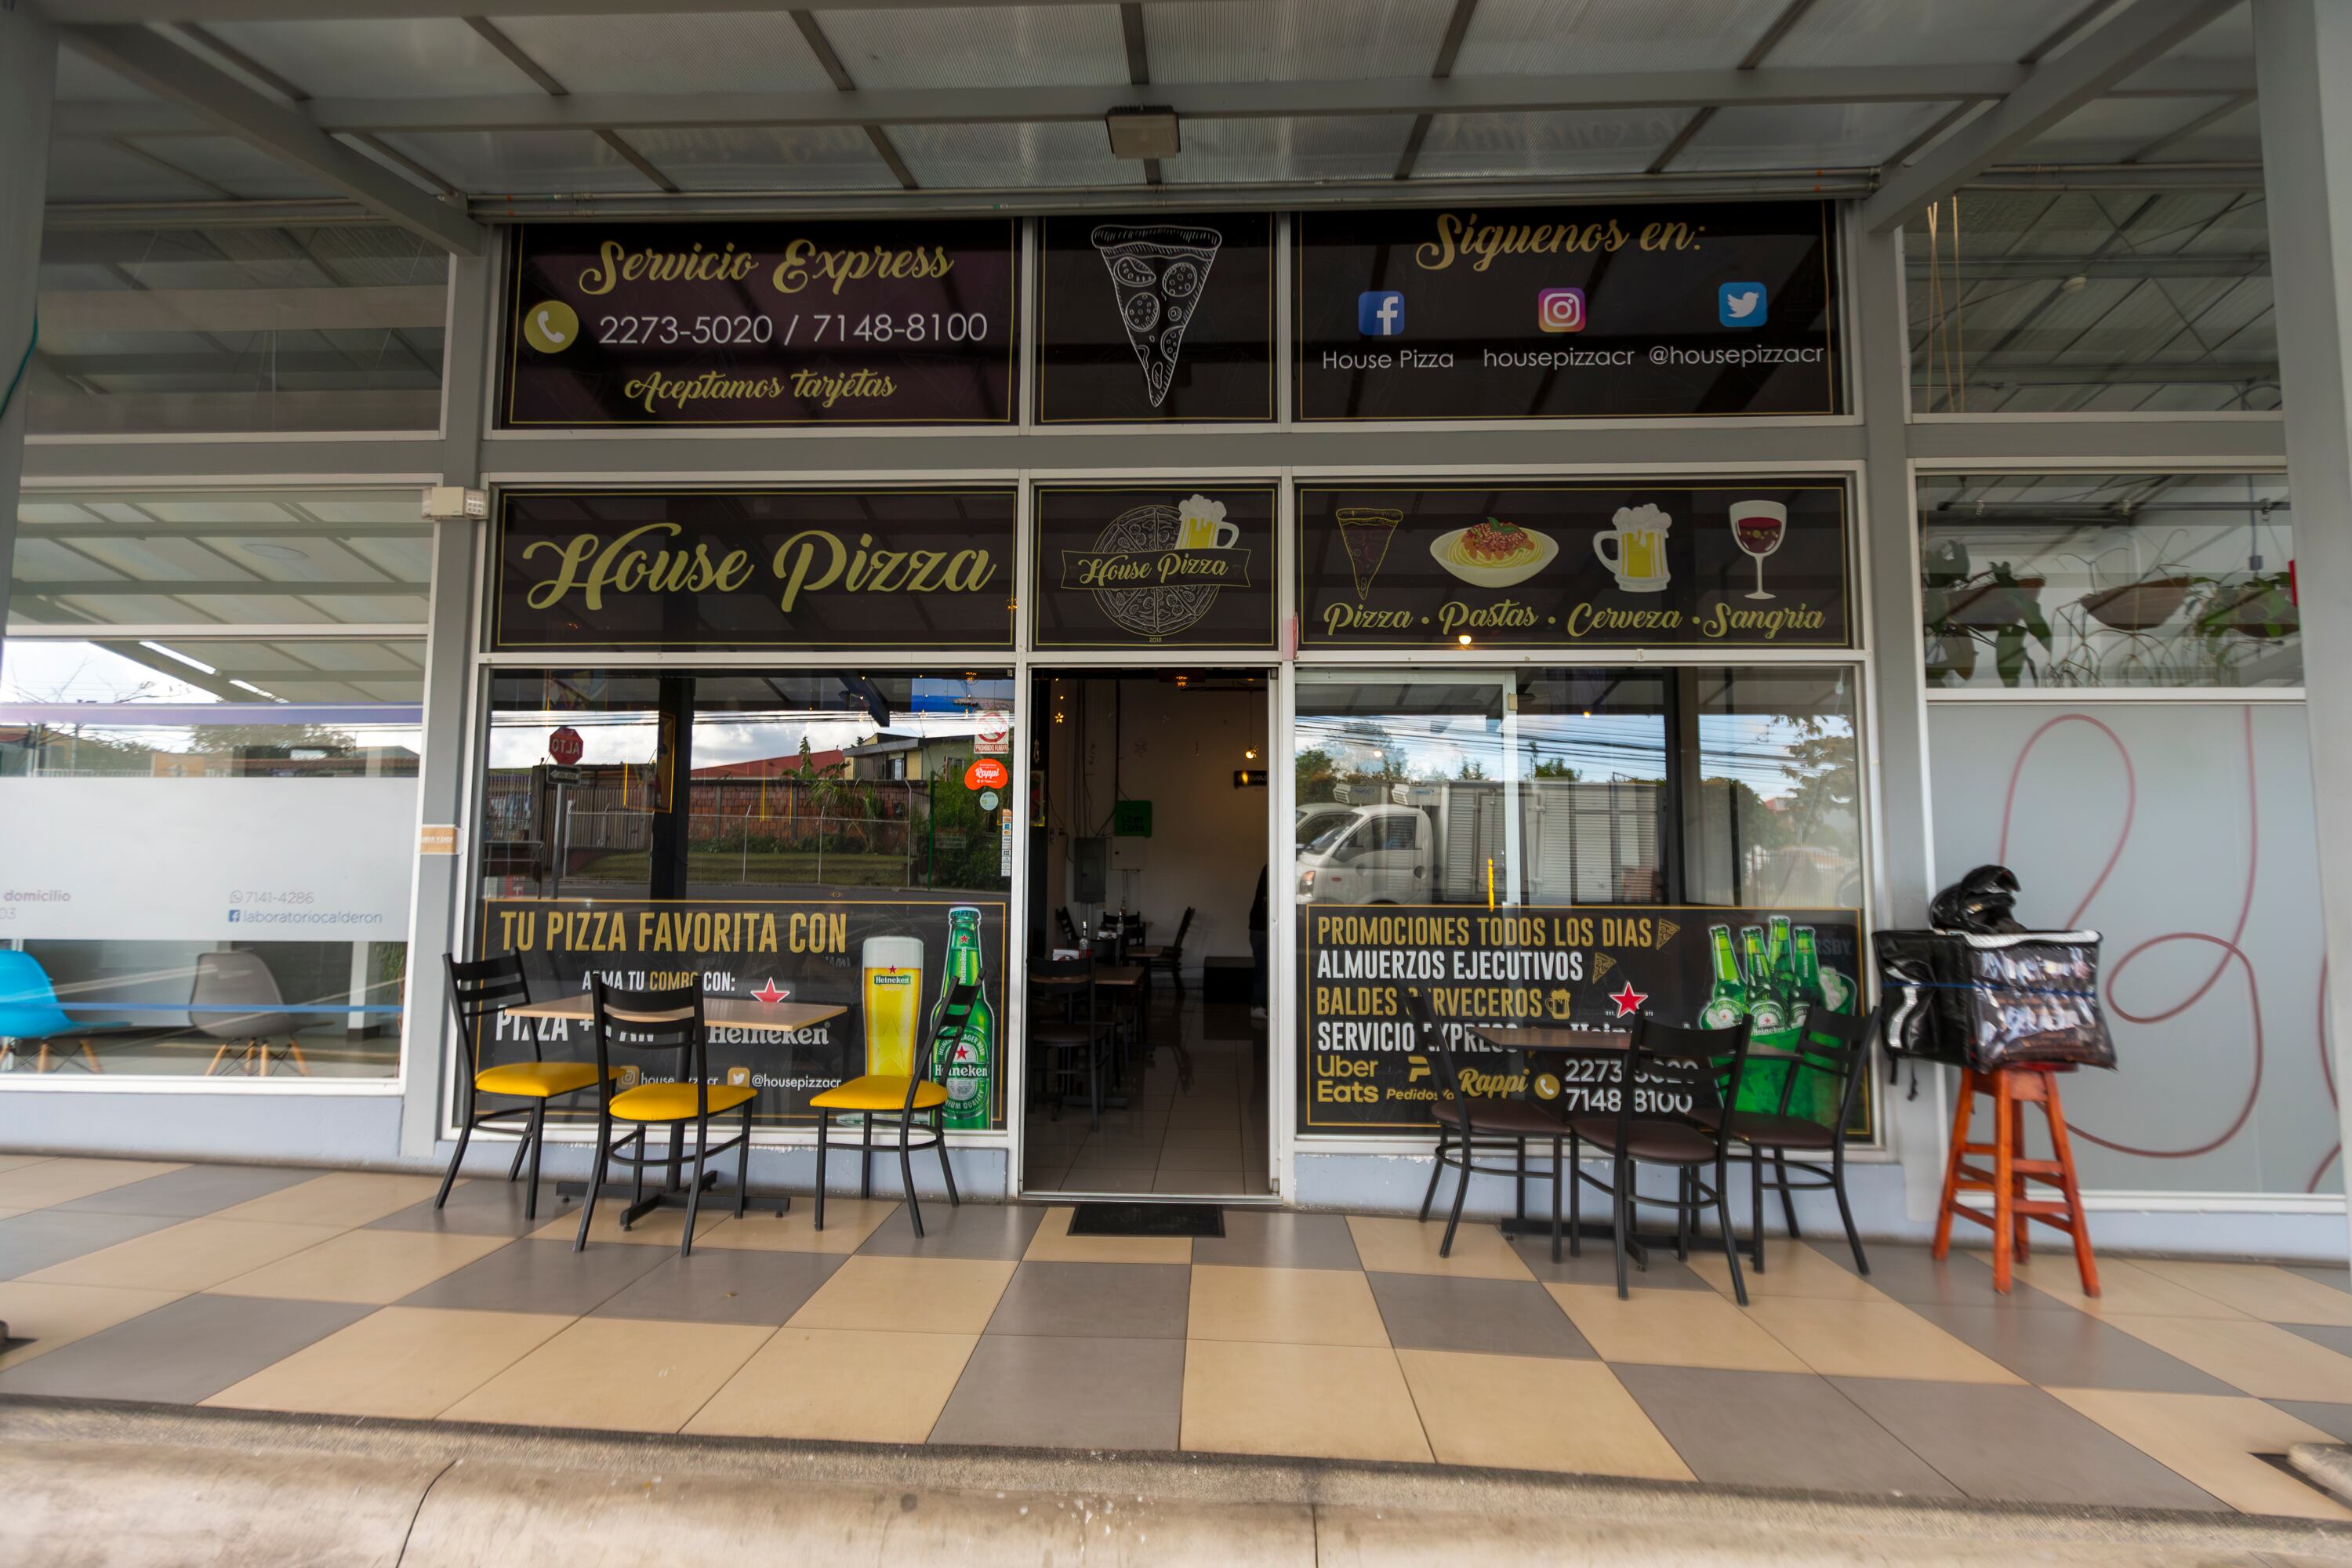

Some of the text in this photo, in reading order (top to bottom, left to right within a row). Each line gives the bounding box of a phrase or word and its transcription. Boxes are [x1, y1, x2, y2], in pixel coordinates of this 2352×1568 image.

[1639, 220, 1702, 252] en:
[579, 238, 955, 295] Servicio Express
[599, 315, 773, 344] 2273-5020
[813, 312, 988, 343] 7148-8100
[1322, 349, 1454, 369] House Pizza
[1483, 346, 1635, 371] housepizzacr
[1649, 344, 1824, 368] @housepizzacr
[624, 368, 897, 413] Aceptamos tarjetas
[523, 522, 996, 613] House Pizza
[1078, 552, 1229, 586] House Pizza
[1323, 598, 1826, 640] Pizza Pastas Cerveza Sangria
[975, 768, 1000, 779] Rappi
[3, 889, 71, 902] domicilio
[245, 891, 314, 904] 7141-4286
[243, 909, 383, 924] laboratoriocalderon
[499, 911, 847, 954] TU PIZZA FAVORITA CON
[1318, 916, 1652, 948] PROMOCIONES TODOS LOS DIAS
[1317, 949, 1584, 981] ALMUERZOS EJECUTIVOS
[628, 971, 644, 991] TU
[703, 971, 735, 992] CON:
[1316, 987, 1397, 1016] BALDES
[1317, 1022, 1415, 1052] SERVICIO
[1317, 1055, 1378, 1078] Uber
[751, 1073, 842, 1091] @housepizzacr
[1317, 1080, 1379, 1103] Eats
[1458, 1067, 1530, 1099] Rappi
